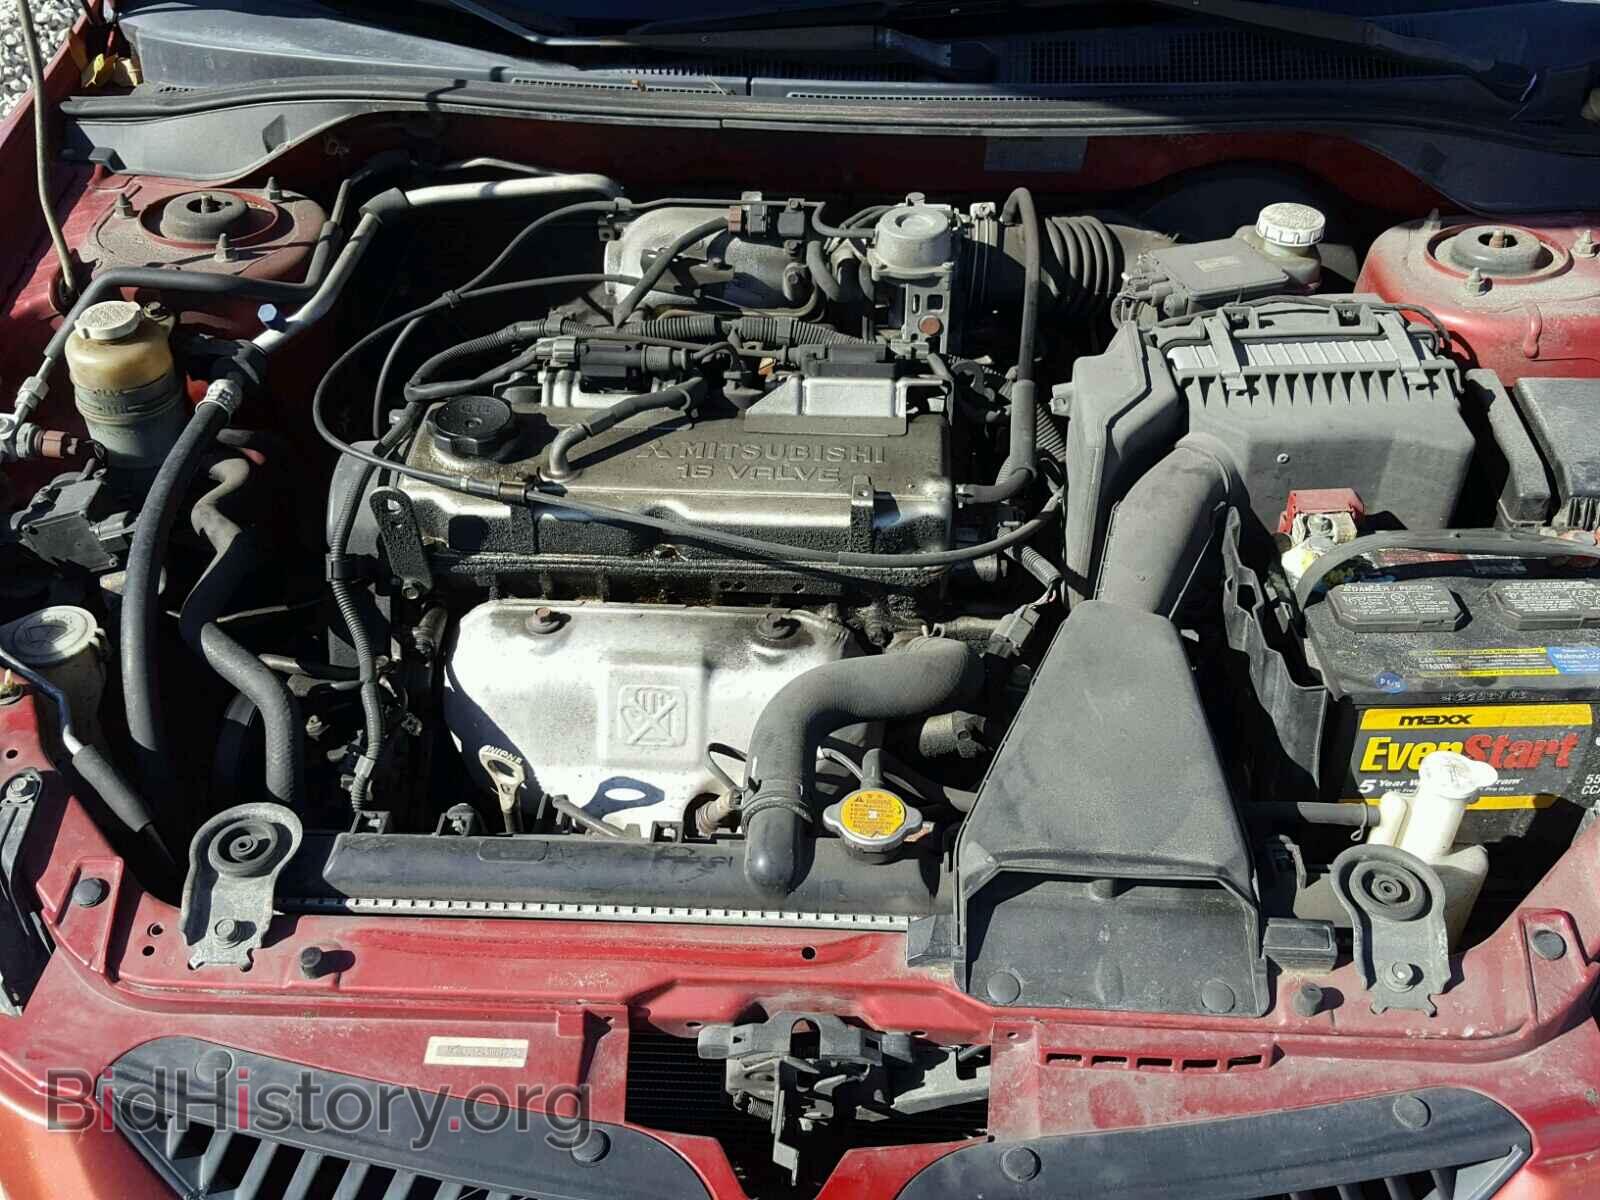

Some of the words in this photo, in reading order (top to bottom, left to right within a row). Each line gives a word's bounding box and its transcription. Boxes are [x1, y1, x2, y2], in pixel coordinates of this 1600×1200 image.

[678, 440, 887, 465] MITSUBISHI
[677, 464, 711, 481] 16
[727, 463, 842, 483] VALVE
[1398, 713, 1474, 727] maxx
[1358, 779, 1377, 794] 5
[1379, 779, 1407, 787] Year
